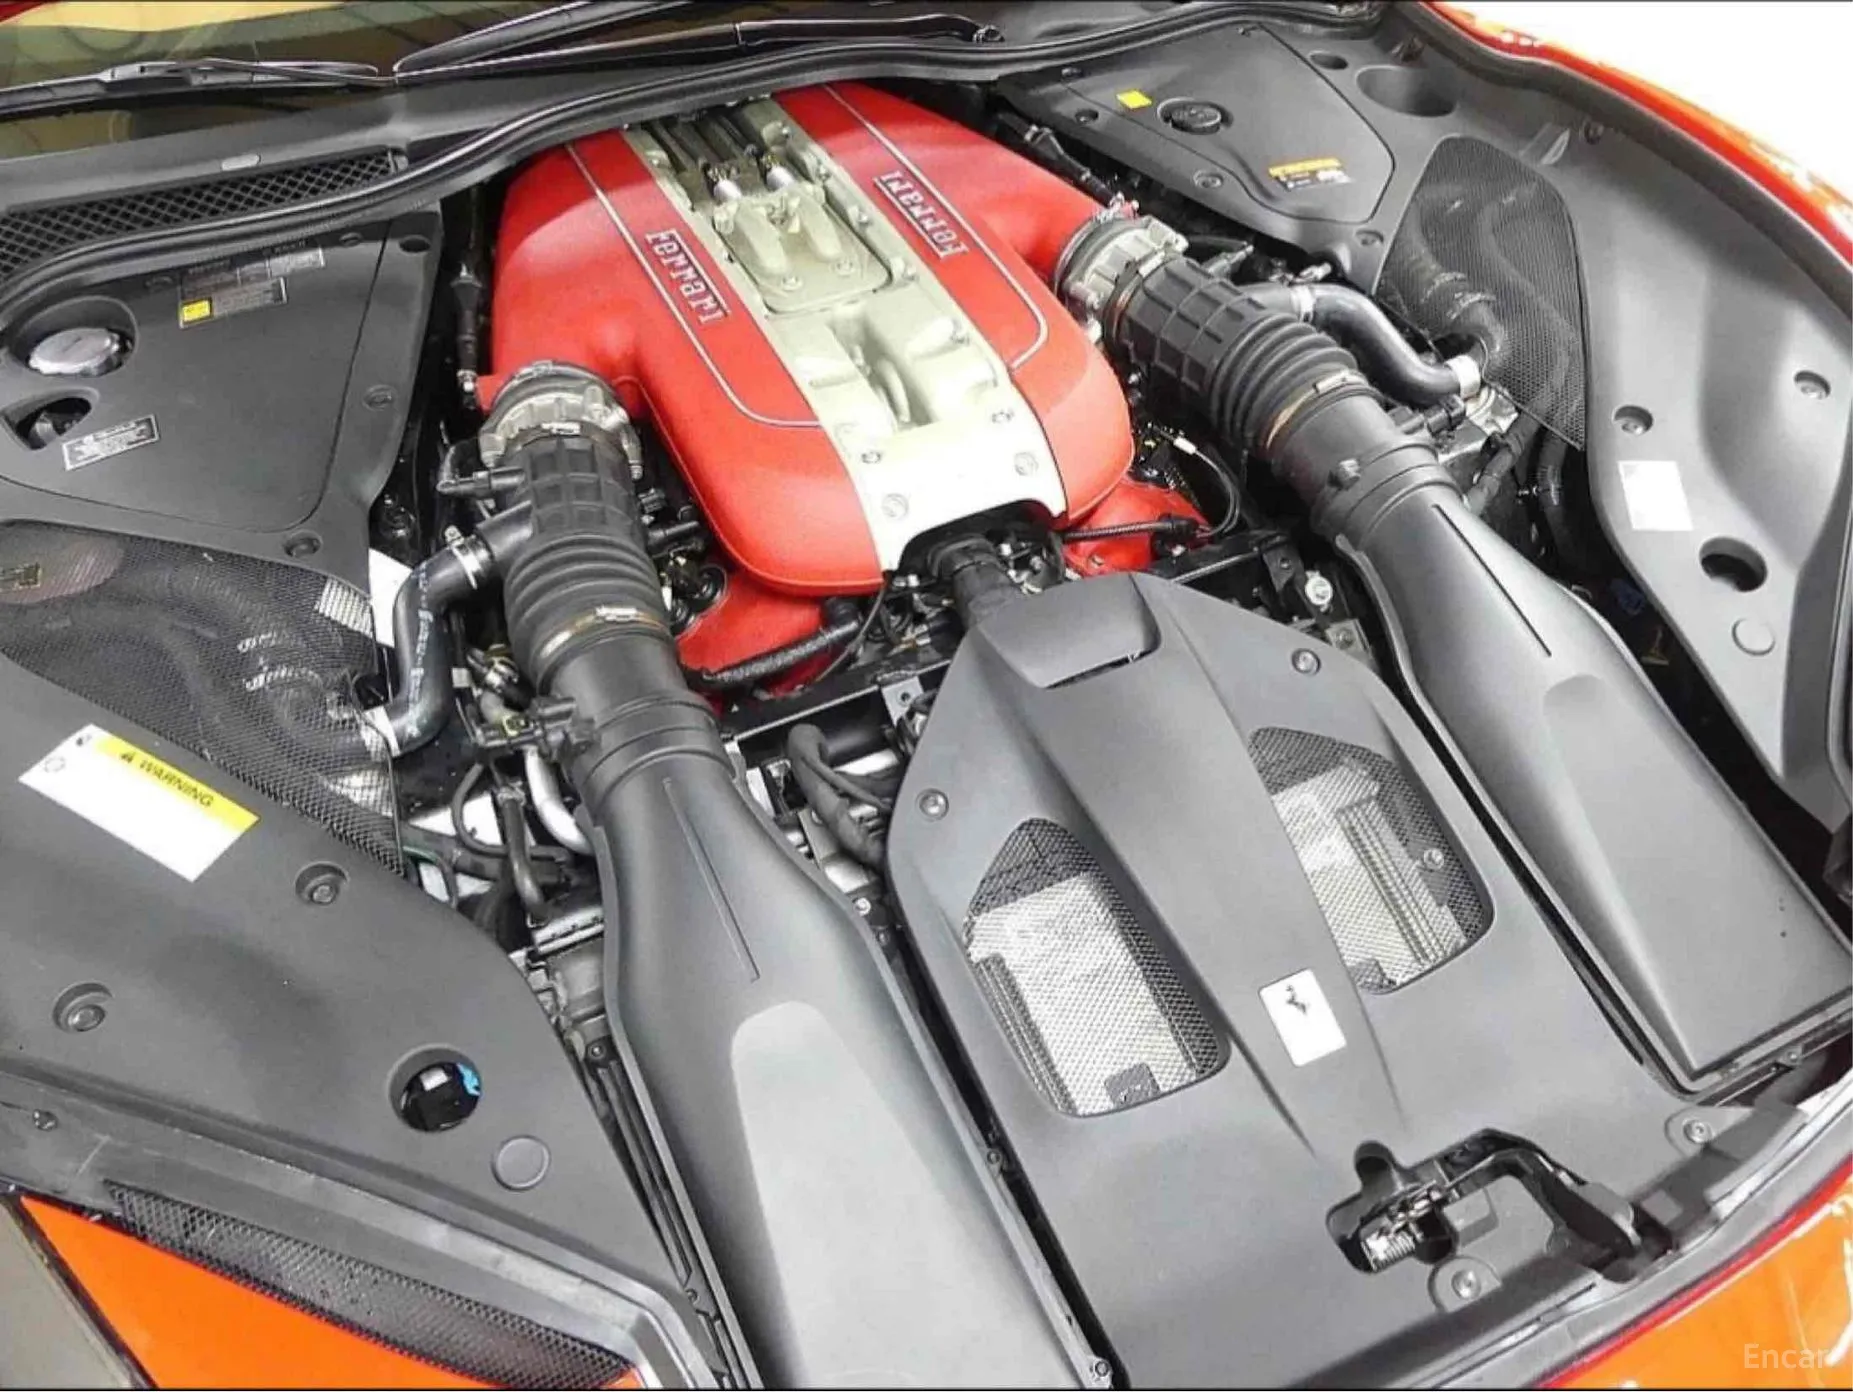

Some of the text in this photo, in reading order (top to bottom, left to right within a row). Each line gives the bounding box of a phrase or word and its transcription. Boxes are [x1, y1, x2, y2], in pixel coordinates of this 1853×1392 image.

[872, 169, 969, 259] Ferrari
[645, 228, 731, 324] Ferrari
[139, 758, 214, 807] WARNING
